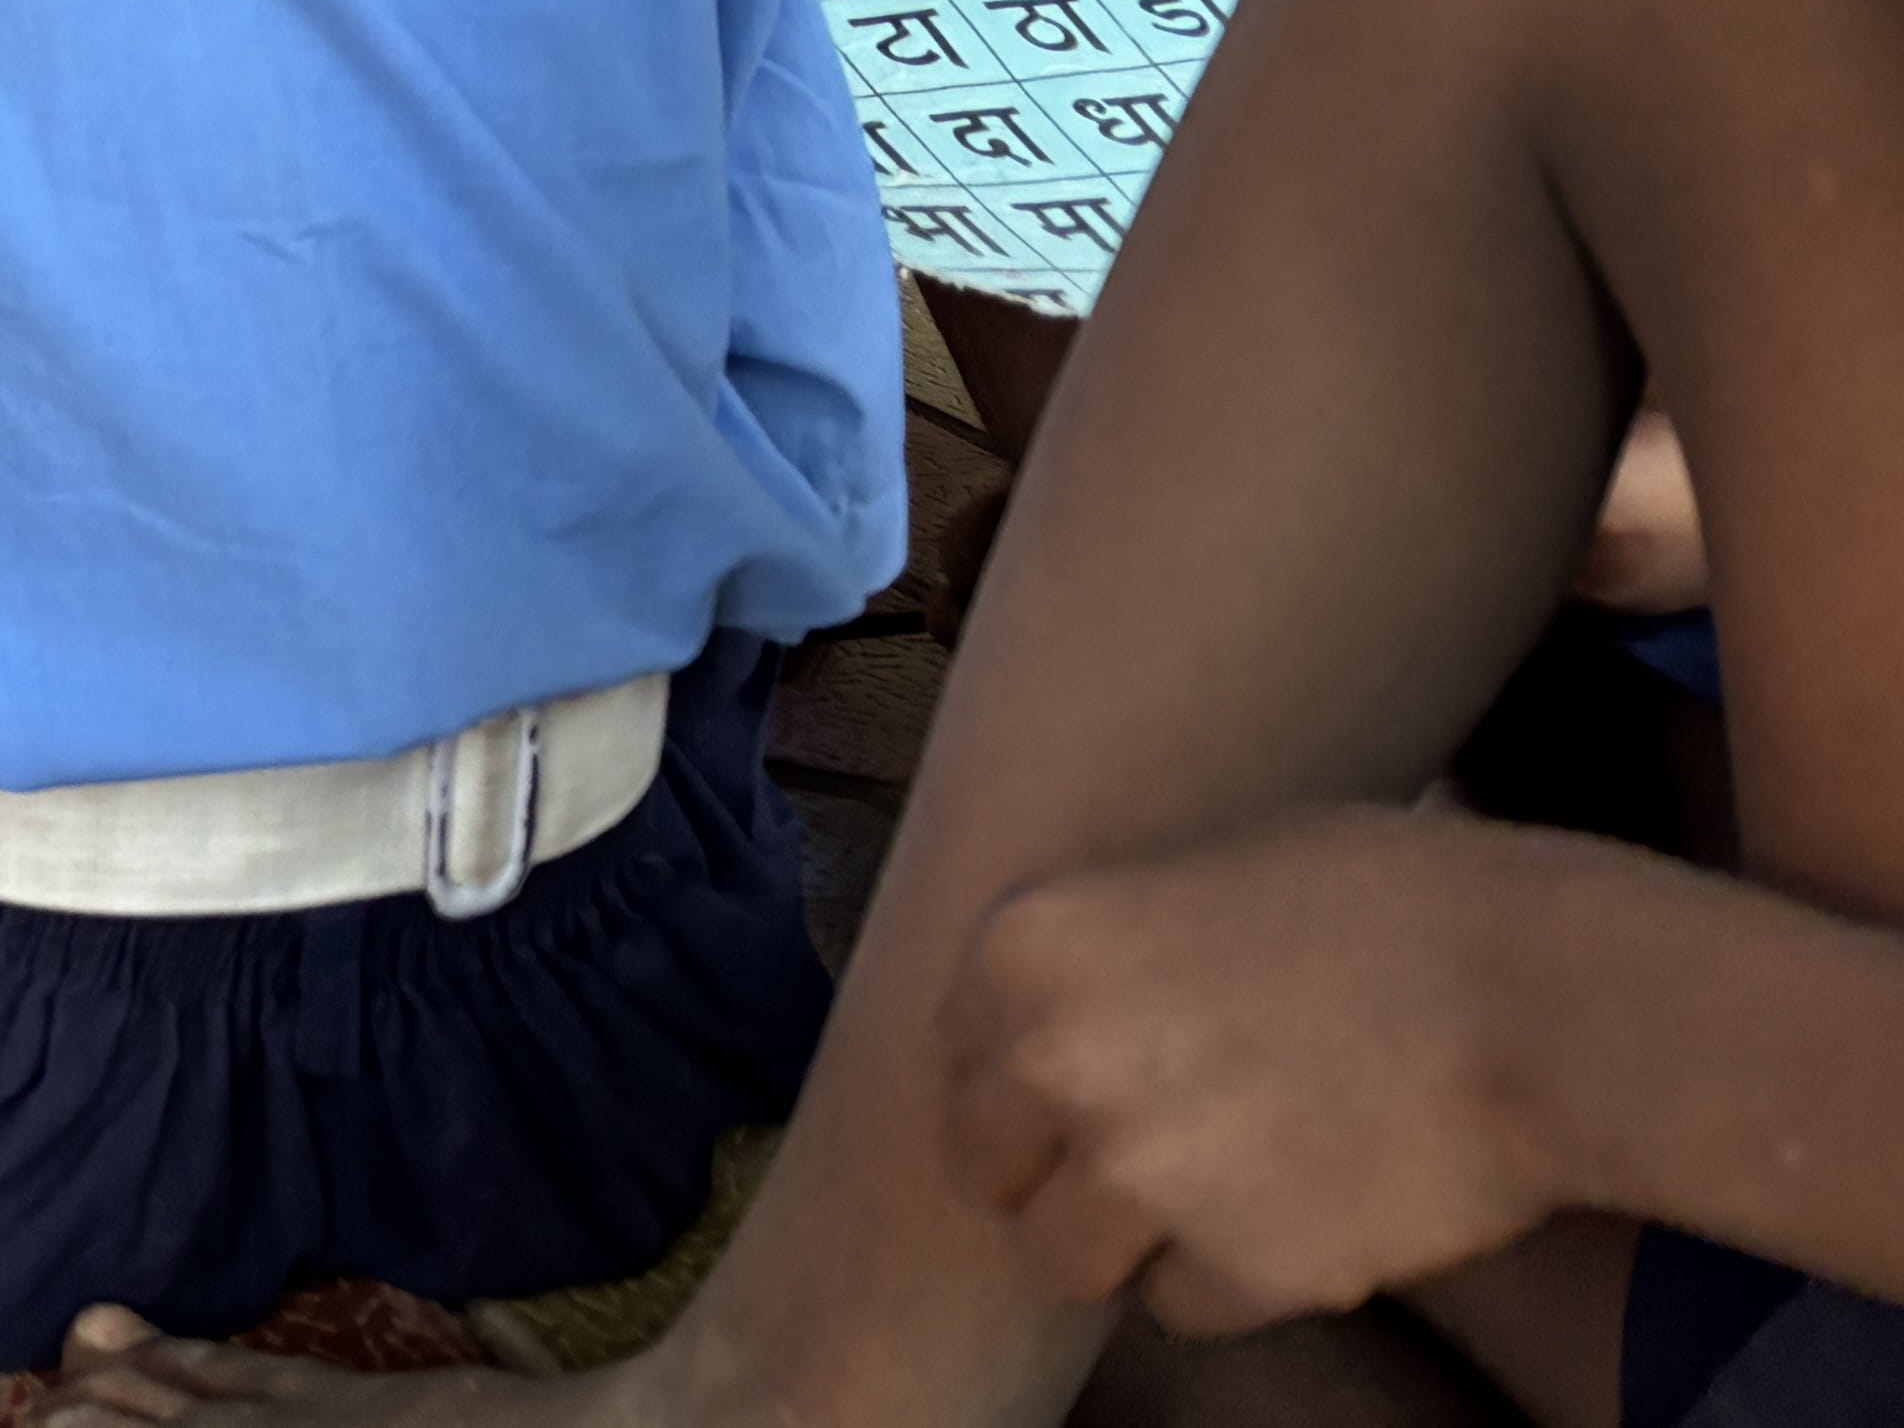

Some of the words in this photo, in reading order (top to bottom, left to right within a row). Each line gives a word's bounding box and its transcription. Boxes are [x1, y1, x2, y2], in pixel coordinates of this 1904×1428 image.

[847, 7, 968, 70] टा
[928, 106, 1057, 167] दा
[1072, 94, 1179, 151] धा
